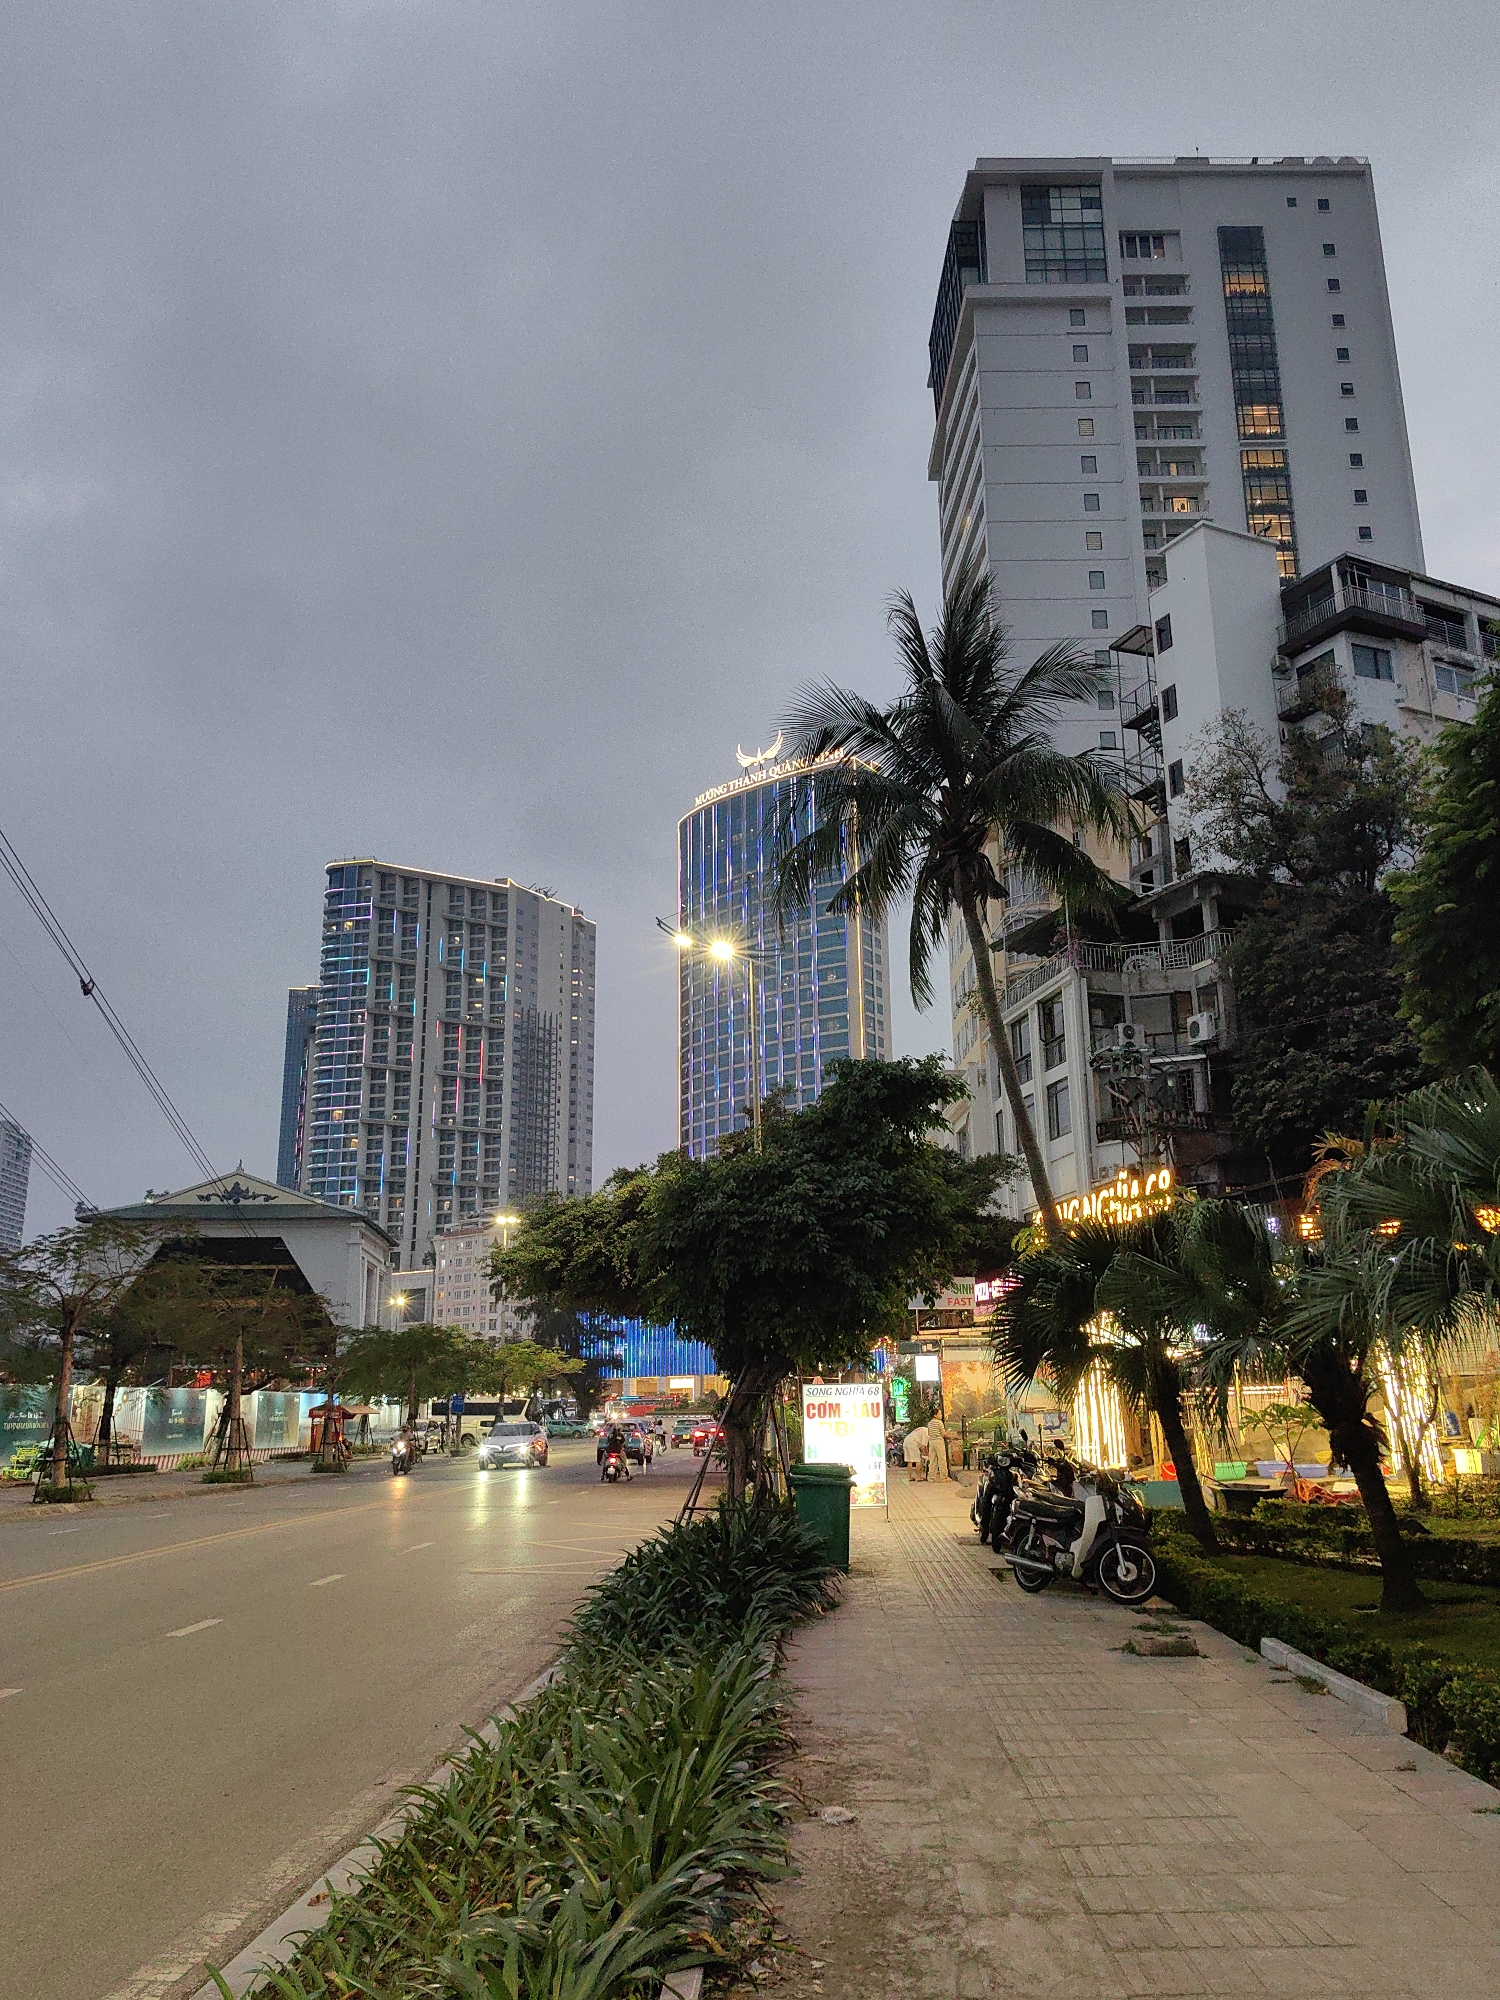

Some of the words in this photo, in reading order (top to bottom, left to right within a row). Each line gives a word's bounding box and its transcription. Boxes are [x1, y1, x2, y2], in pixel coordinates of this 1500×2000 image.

[695, 785, 728, 806] MƯỜNG
[729, 769, 767, 792] THANH
[947, 1297, 973, 1306] FAST
[805, 1387, 833, 1396] SONG
[835, 1385, 865, 1396] NGHĨA
[867, 1386, 880, 1396] 68
[806, 1400, 841, 1419] CƠM
